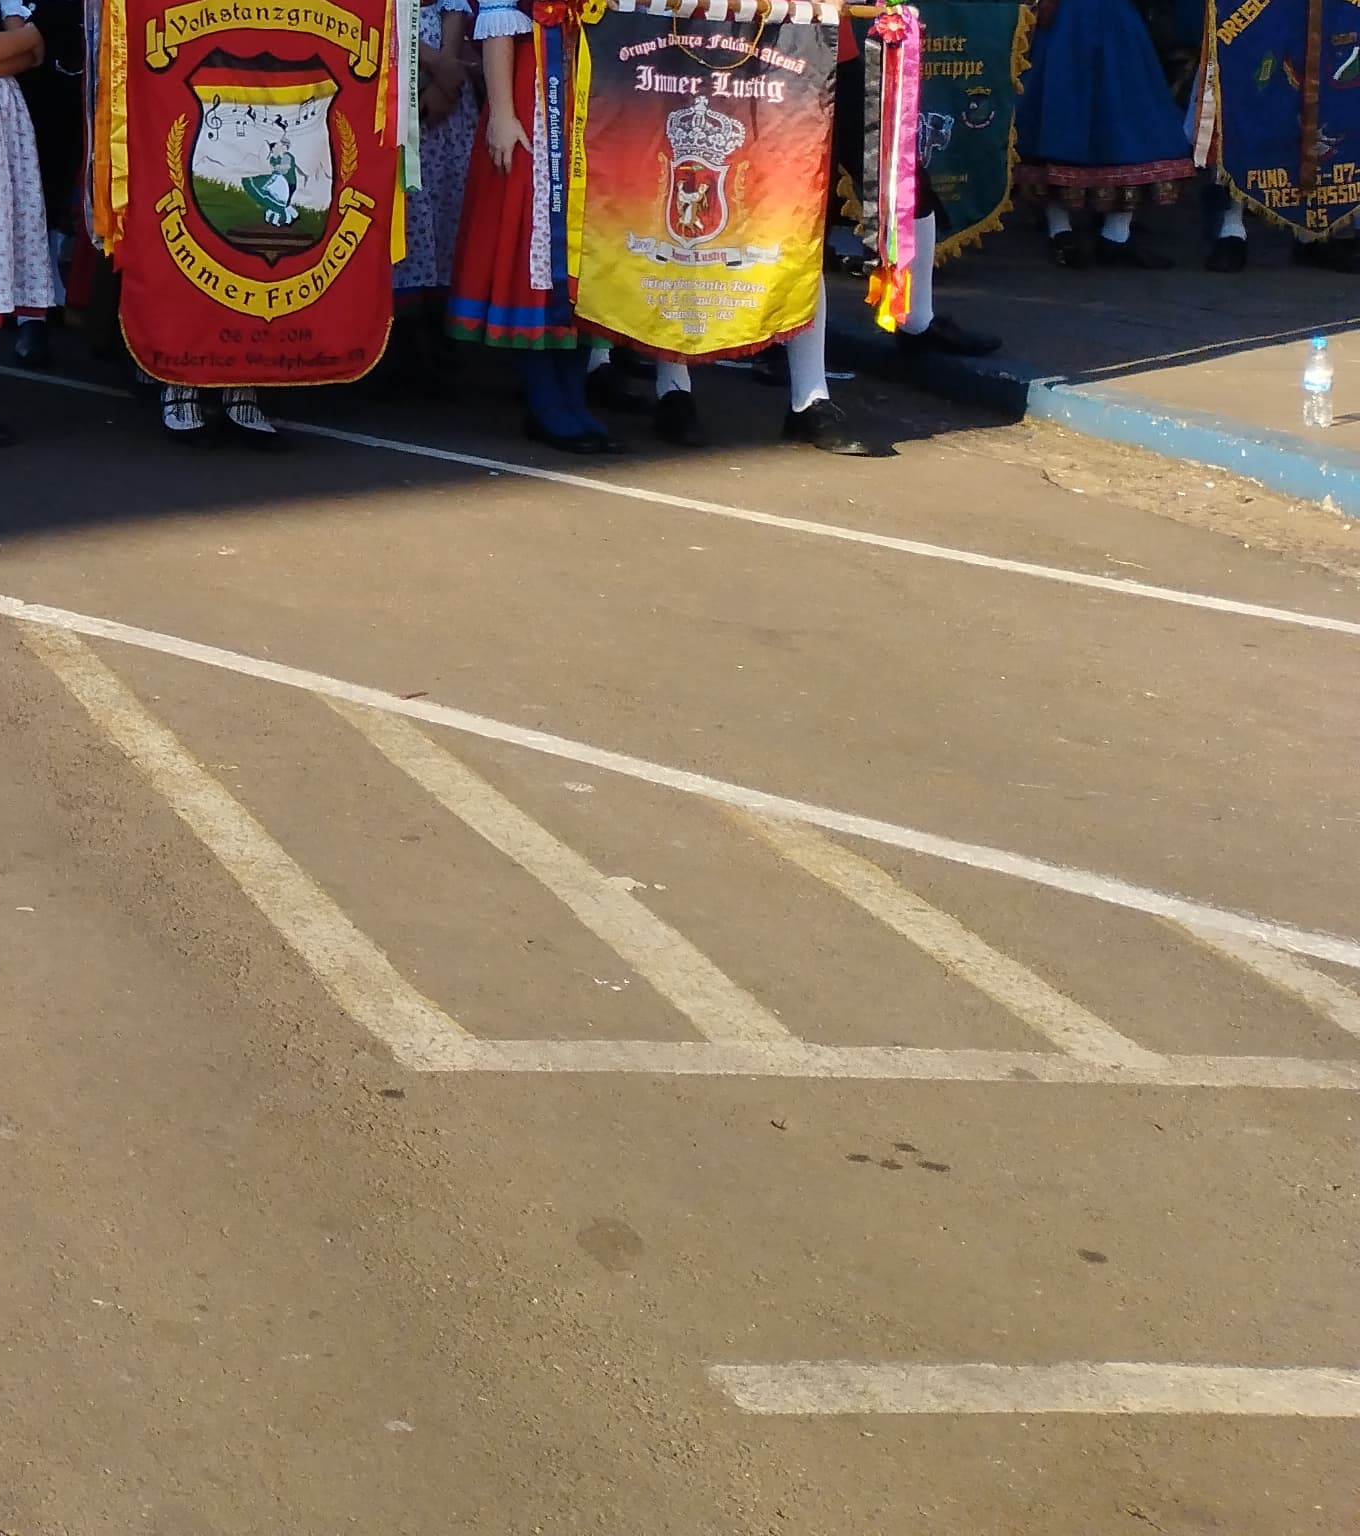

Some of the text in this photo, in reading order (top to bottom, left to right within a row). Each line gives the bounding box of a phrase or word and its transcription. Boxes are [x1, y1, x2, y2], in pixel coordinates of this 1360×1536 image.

[169, 1, 362, 43] Volkstanzgruppe
[618, 43, 656, 62] Grupo
[758, 47, 808, 75] Alemã
[549, 76, 560, 105] Grupo
[634, 64, 786, 104] Immer Lustig
[1247, 168, 1292, 190] FUND.
[1263, 187, 1300, 208] TRES
[1306, 208, 1329, 228] RS
[265, 228, 360, 309] Fröhlich
